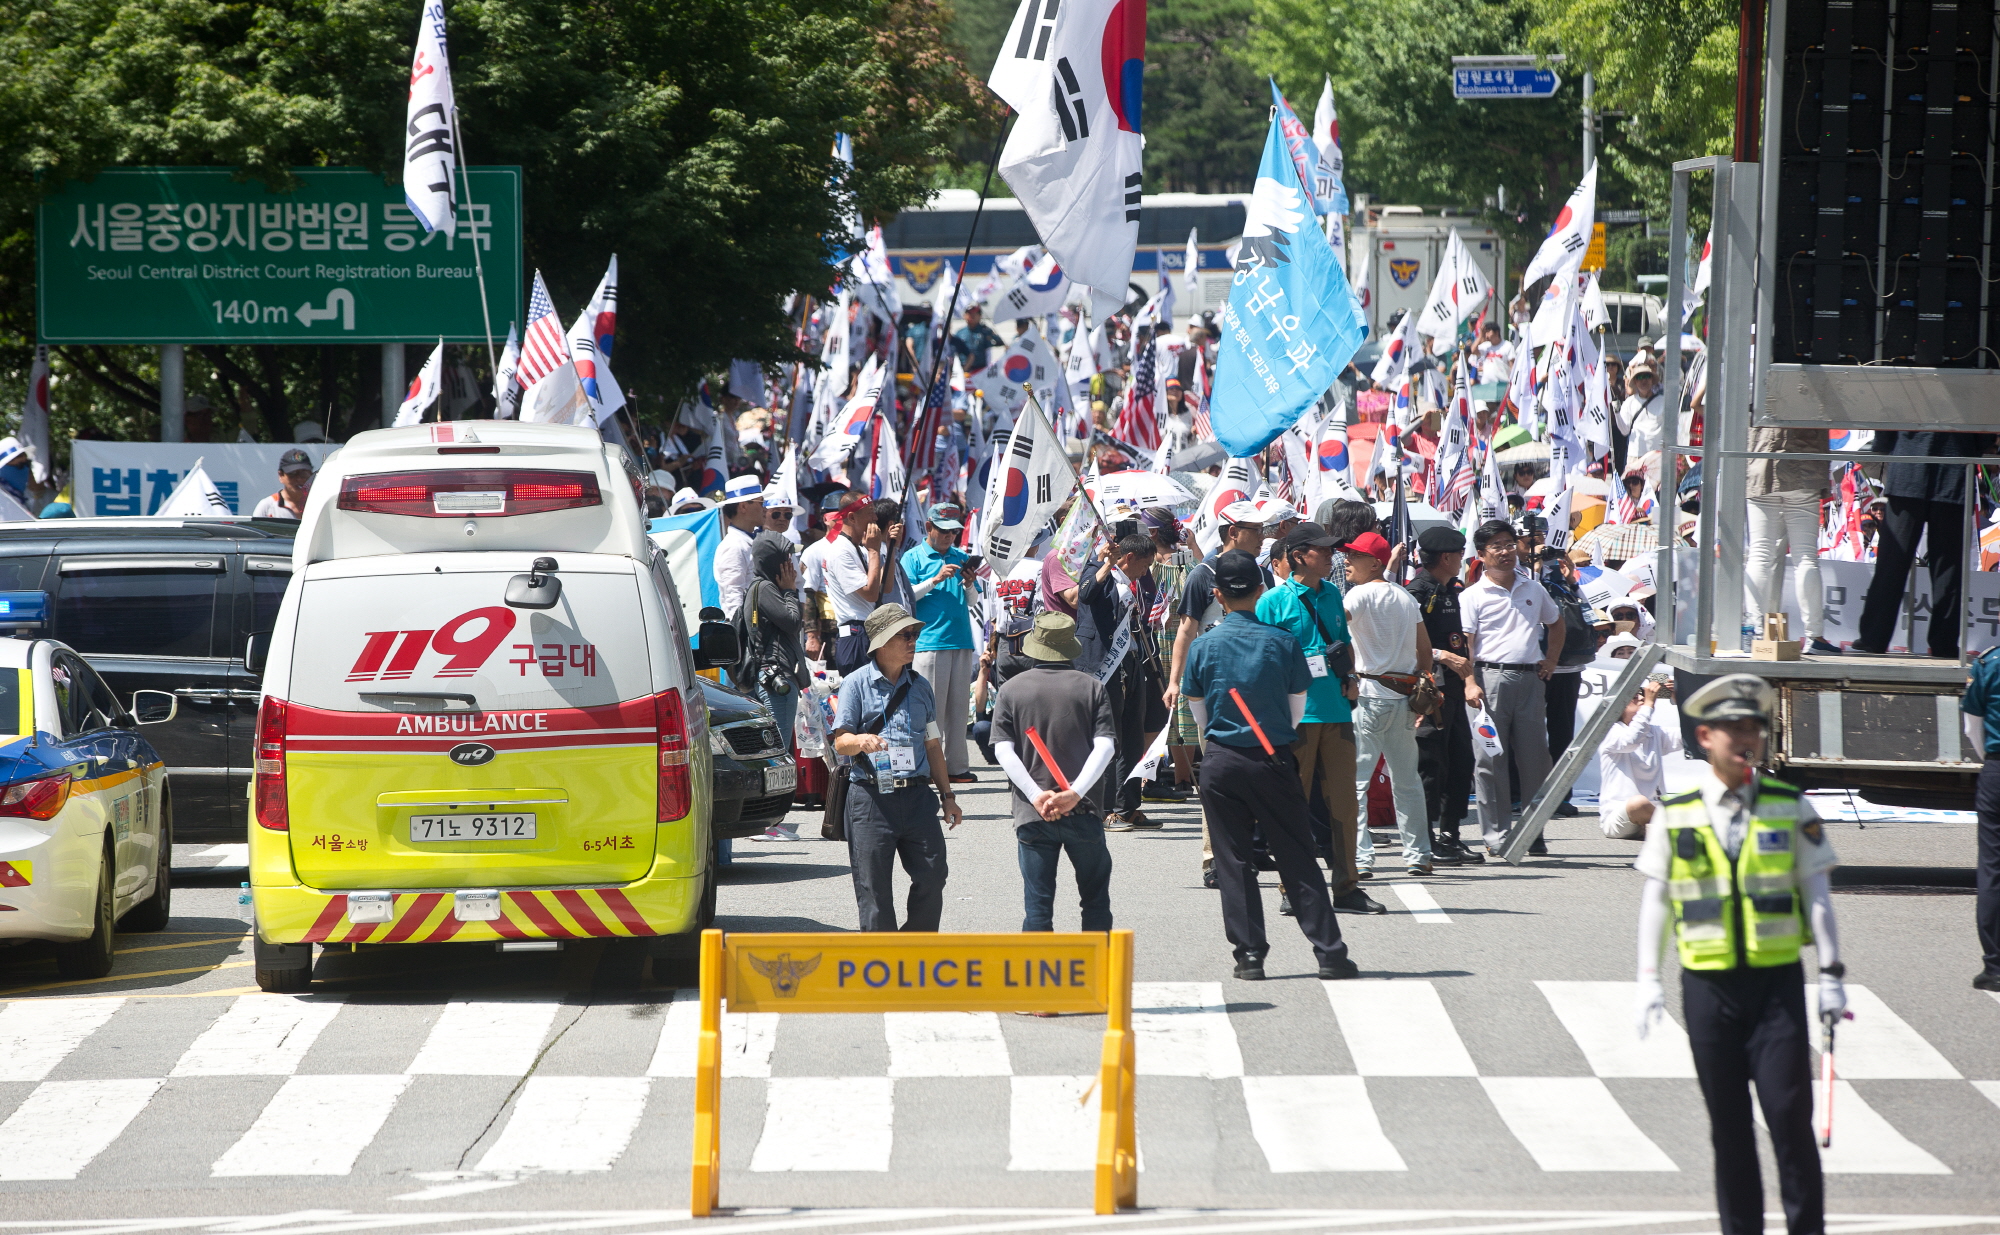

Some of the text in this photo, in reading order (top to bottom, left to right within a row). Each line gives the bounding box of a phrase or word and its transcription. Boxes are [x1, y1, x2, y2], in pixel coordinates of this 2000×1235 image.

[69, 203, 369, 252] 서울중앙지방법원
[87, 263, 473, 282] Seoul Central District Court Registration Bureau
[1233, 246, 1317, 376] 강남우파
[1246, 346, 1267, 378] 그리고
[1264, 375, 1282, 395] 자유
[344, 606, 517, 682] 119
[509, 643, 596, 677] 구급대
[396, 712, 549, 735] AMBULANCE
[456, 747, 488, 761] 119
[421, 816, 526, 839] 71노 9312
[837, 959, 1086, 988] POLICE LINE
